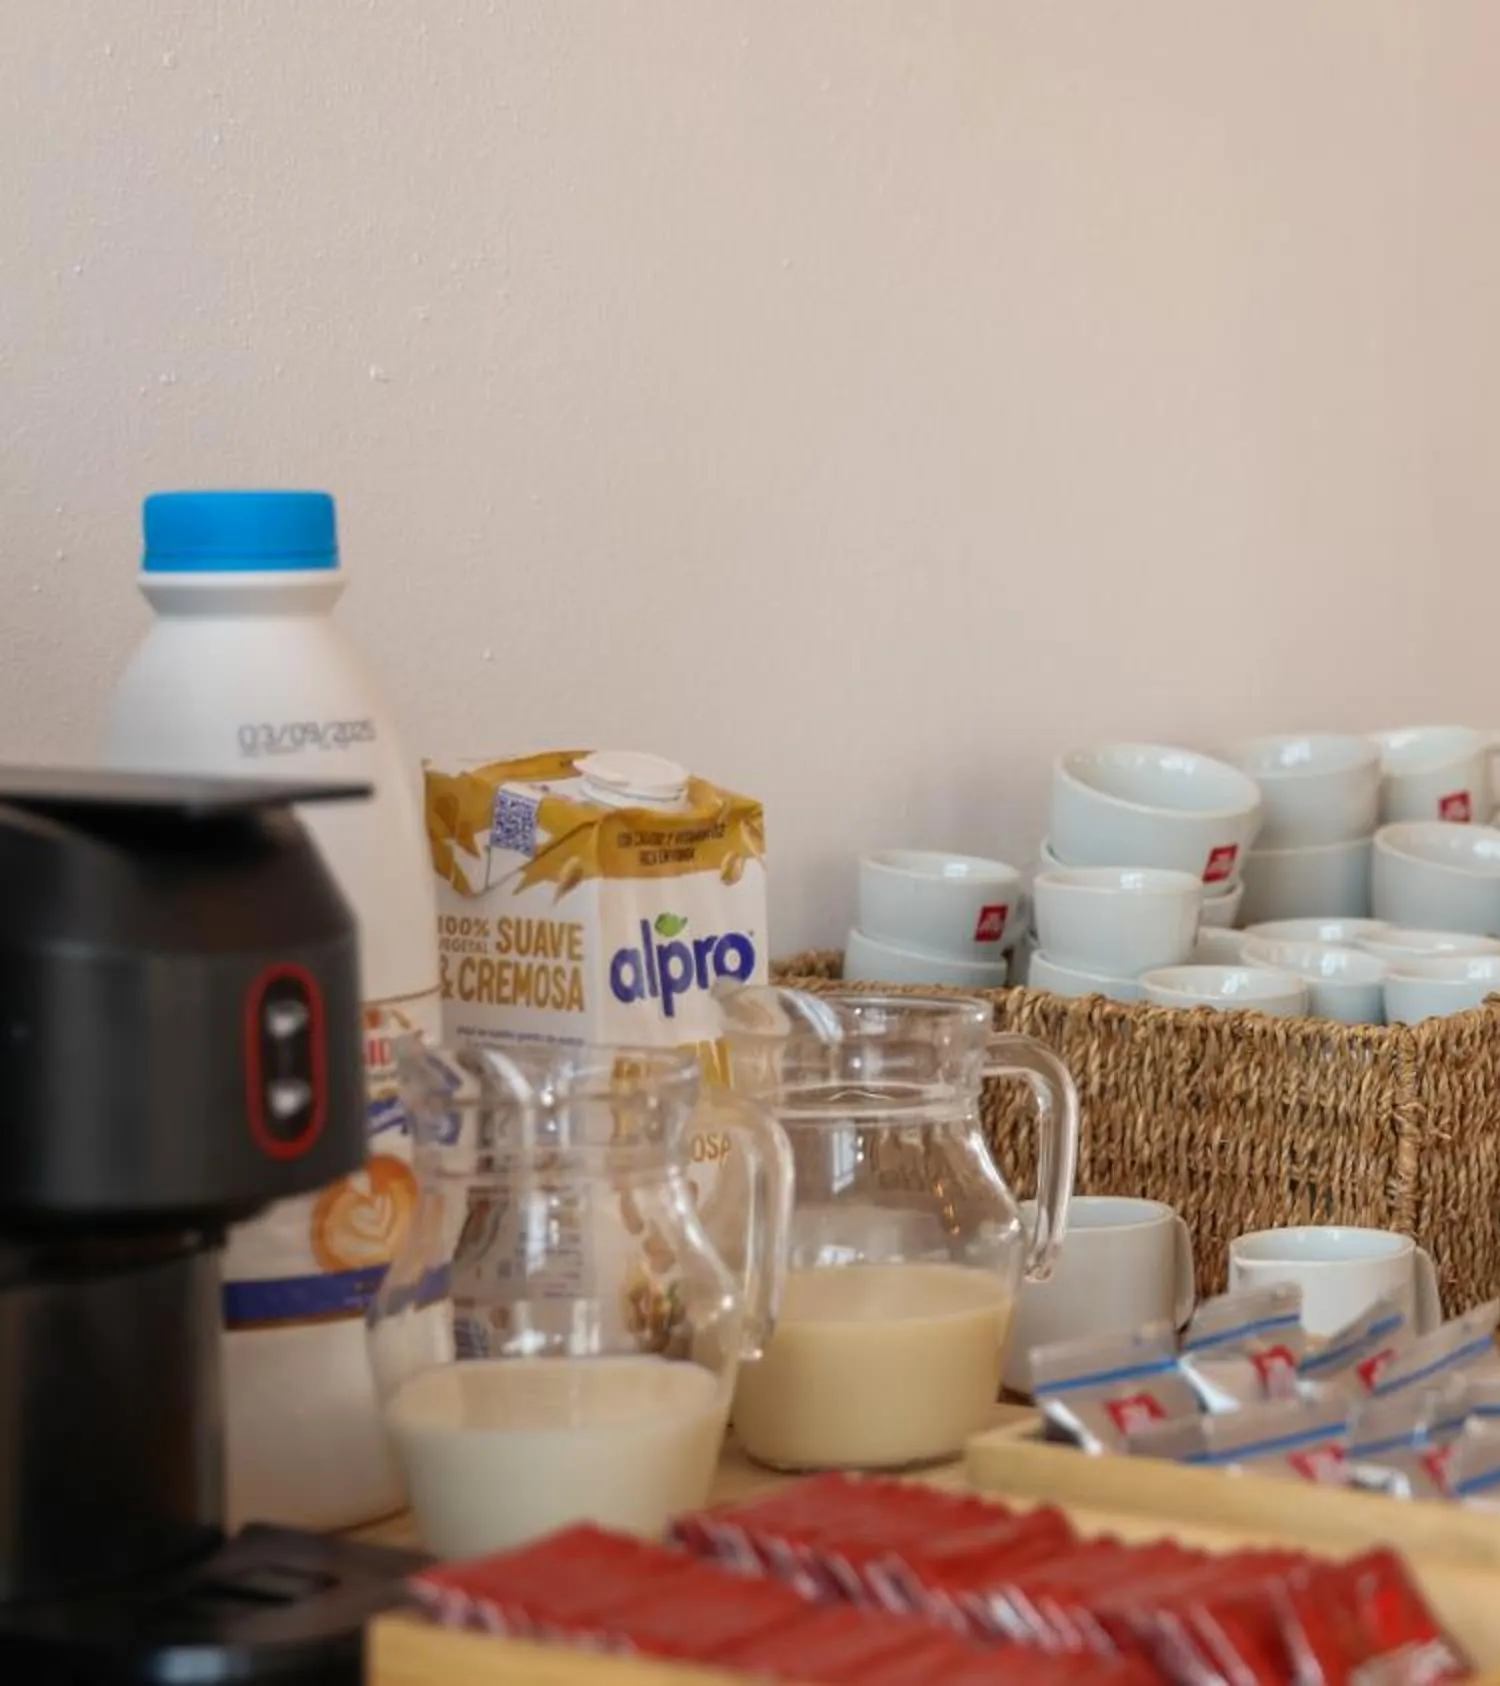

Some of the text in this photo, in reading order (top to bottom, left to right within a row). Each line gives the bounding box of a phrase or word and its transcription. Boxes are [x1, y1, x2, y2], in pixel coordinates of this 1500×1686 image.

[438, 915, 489, 936] 100%
[496, 915, 584, 961] SUAVE
[458, 956, 585, 1013] CREMOSA
[610, 919, 755, 1018] alpro
